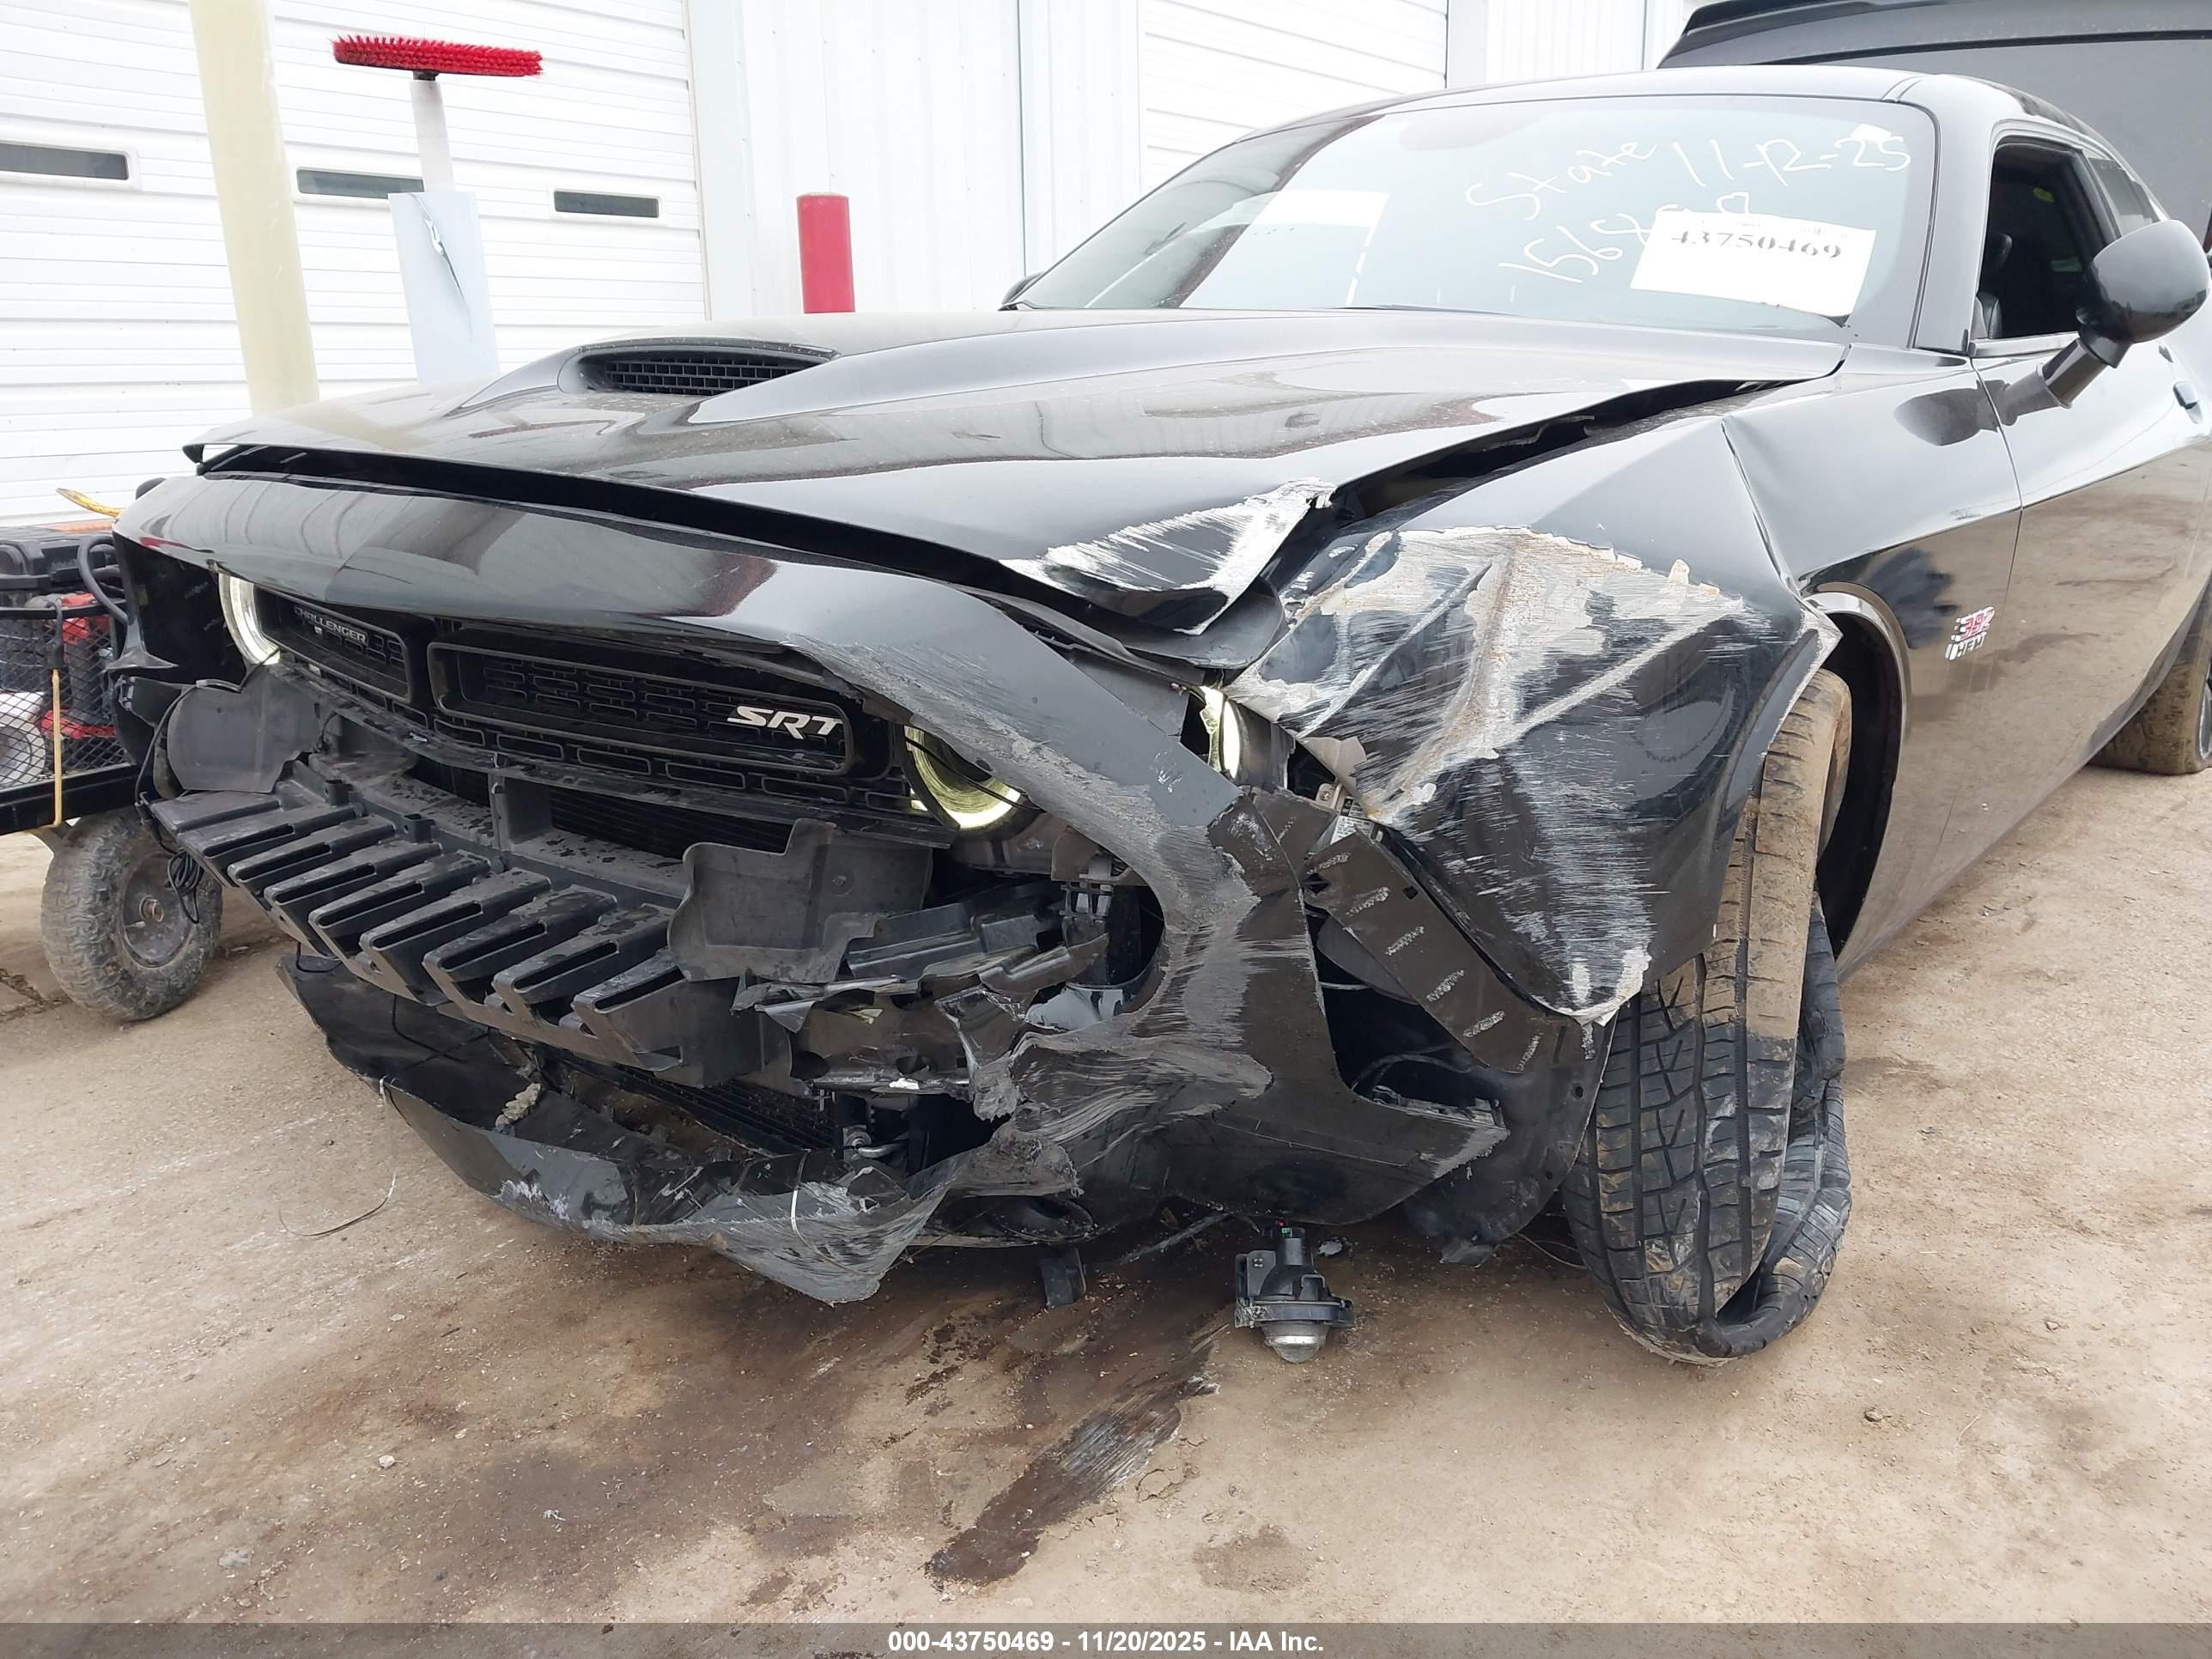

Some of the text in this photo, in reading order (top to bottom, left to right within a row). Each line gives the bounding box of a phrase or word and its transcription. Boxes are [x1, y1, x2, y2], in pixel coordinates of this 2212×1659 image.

[1670, 229, 1843, 259] 43750469
[294, 605, 368, 645] CHALLENGER
[726, 705, 843, 740] SRT
